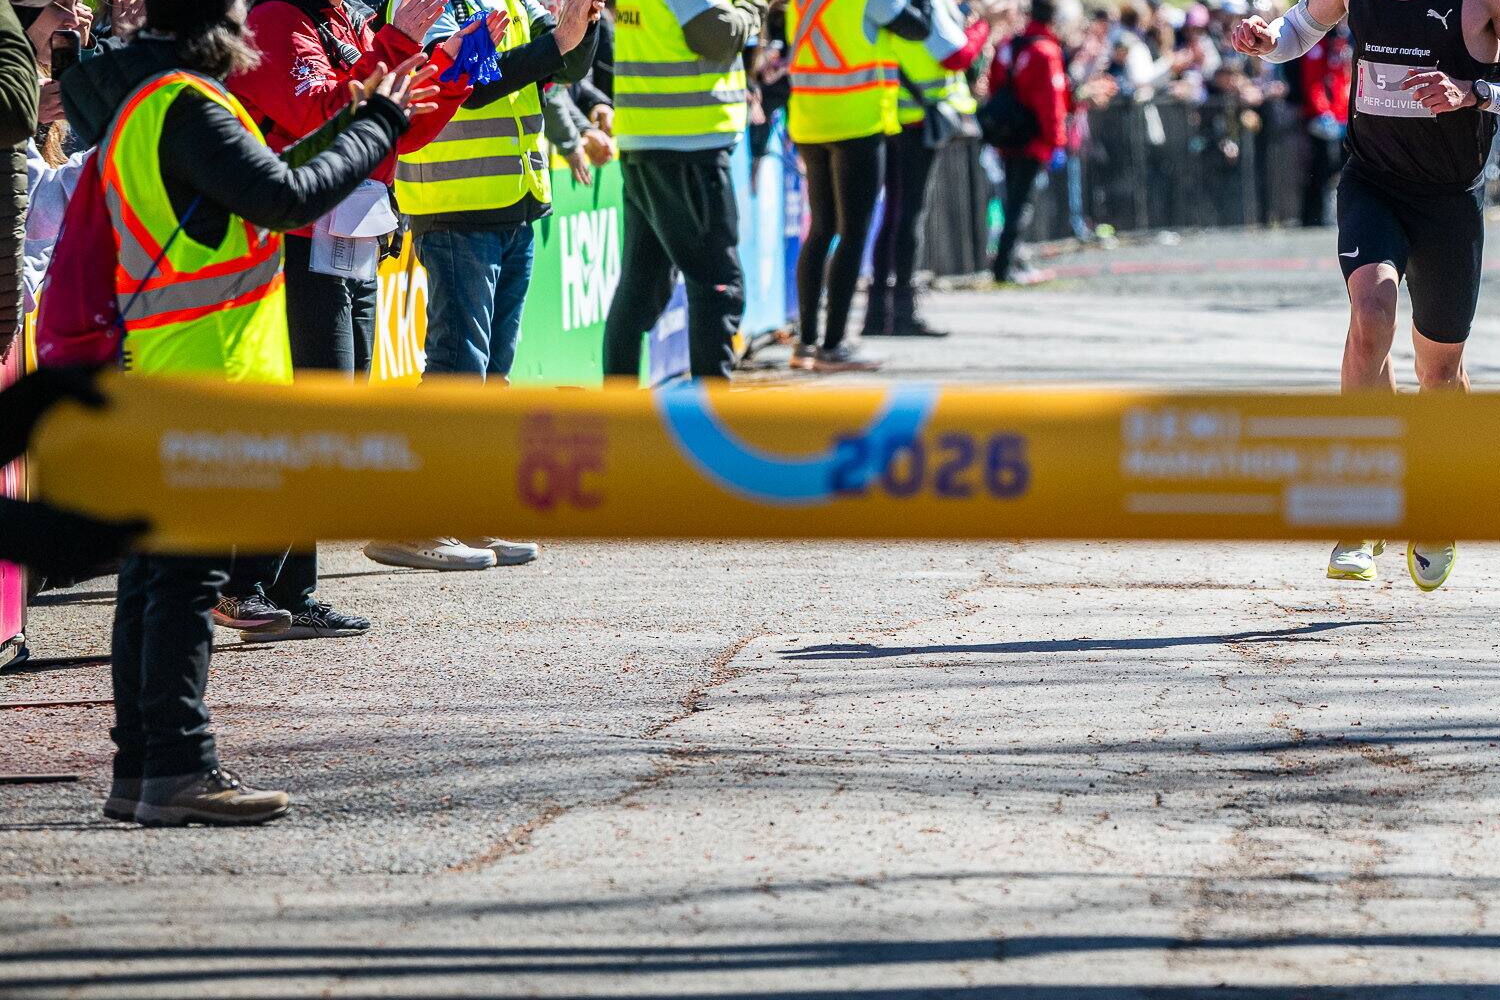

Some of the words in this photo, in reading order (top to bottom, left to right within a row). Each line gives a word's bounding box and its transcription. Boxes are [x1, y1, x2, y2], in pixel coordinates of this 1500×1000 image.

[1371, 45, 1398, 54] coureur
[1399, 47, 1431, 57] nordique
[1376, 74, 1387, 90] 5
[1363, 96, 1424, 109] PIER-OLIVIER
[558, 206, 622, 331] HOKA
[516, 453, 607, 511] QC
[828, 431, 1030, 501] 2026
